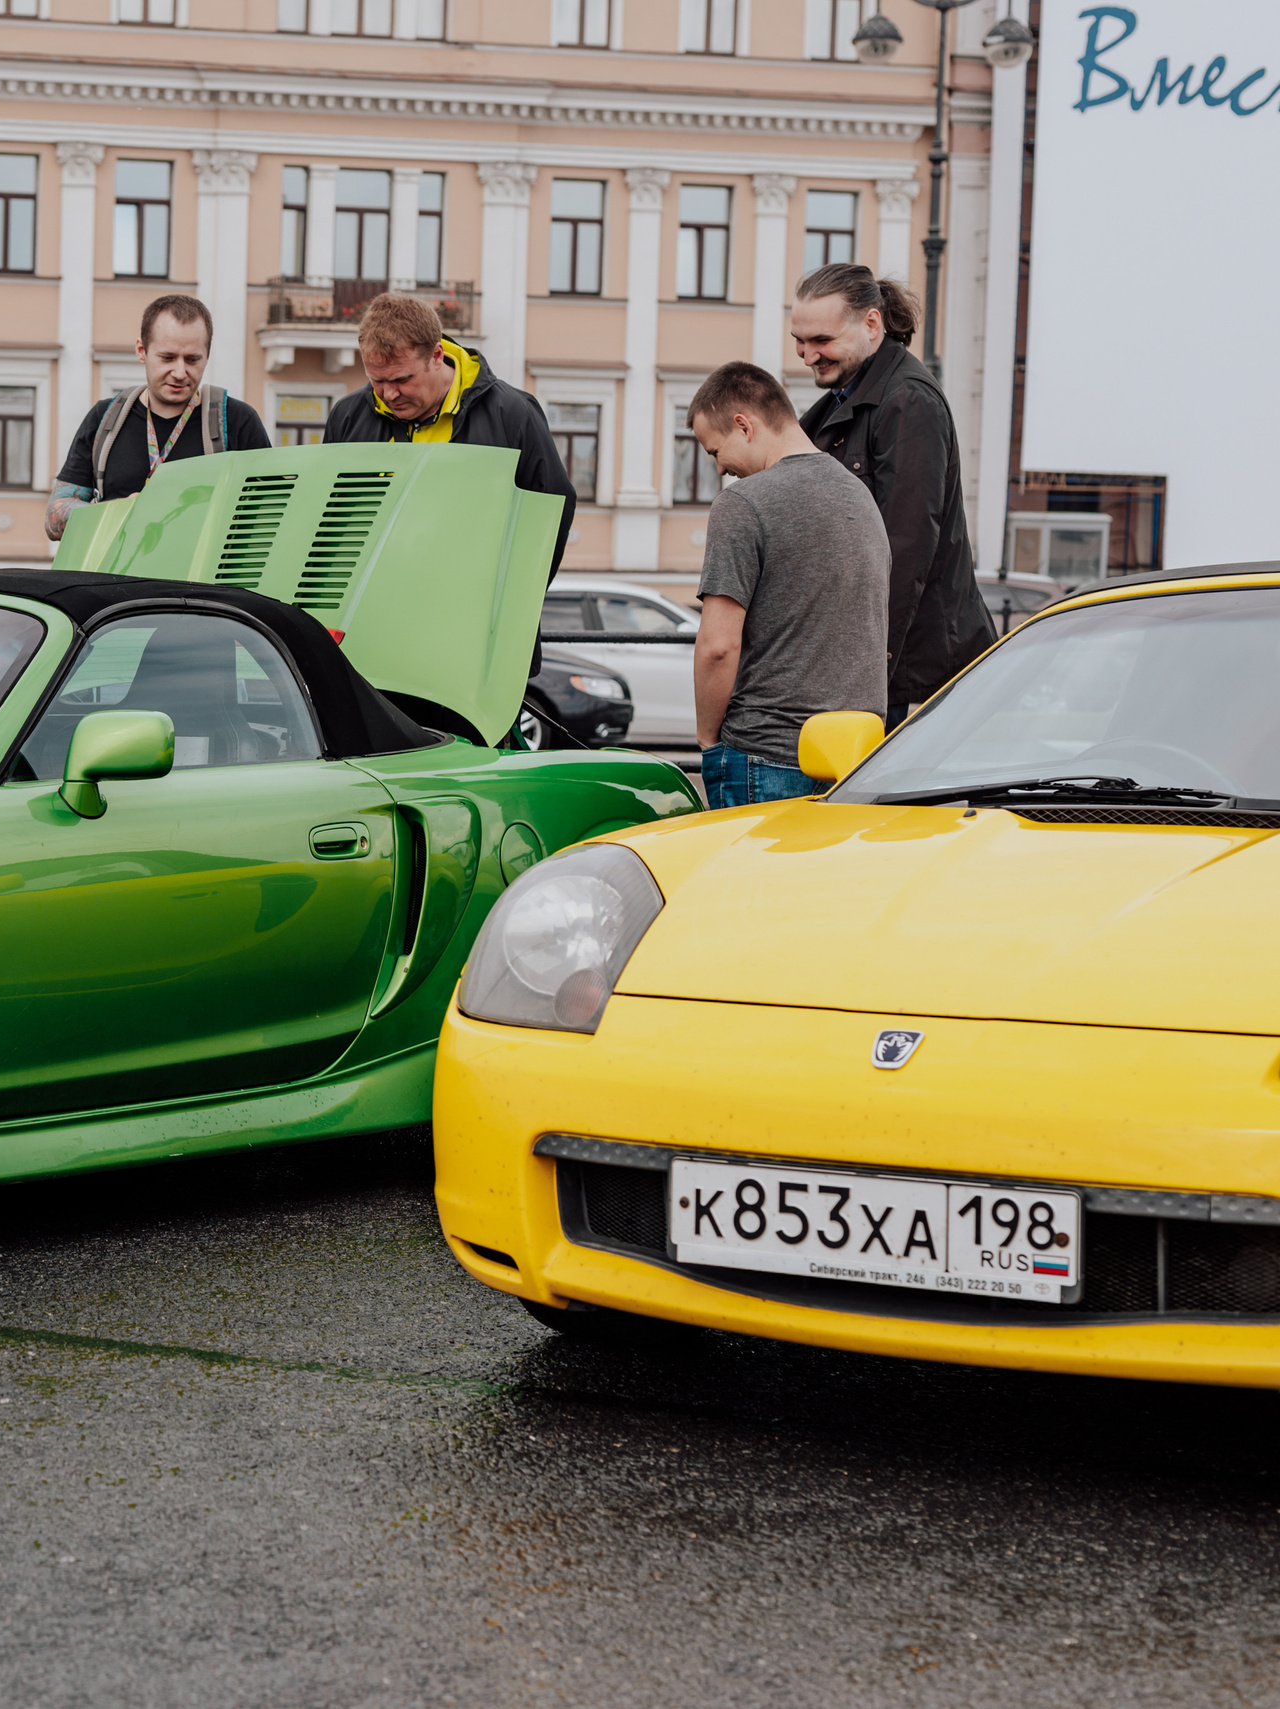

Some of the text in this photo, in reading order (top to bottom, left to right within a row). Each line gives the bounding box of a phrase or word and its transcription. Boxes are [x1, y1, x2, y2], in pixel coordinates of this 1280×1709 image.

[1073, 7, 1280, 116] Вмес
[694, 1178, 1055, 1260] К853ХА 198
[810, 1262, 866, 1279] Сибирский
[936, 1276, 963, 1290] (343)
[967, 1279, 987, 1290] 222
[991, 1281, 1004, 1292] 20
[1008, 1283, 1022, 1294] 50
[980, 1250, 1028, 1272] RUS
